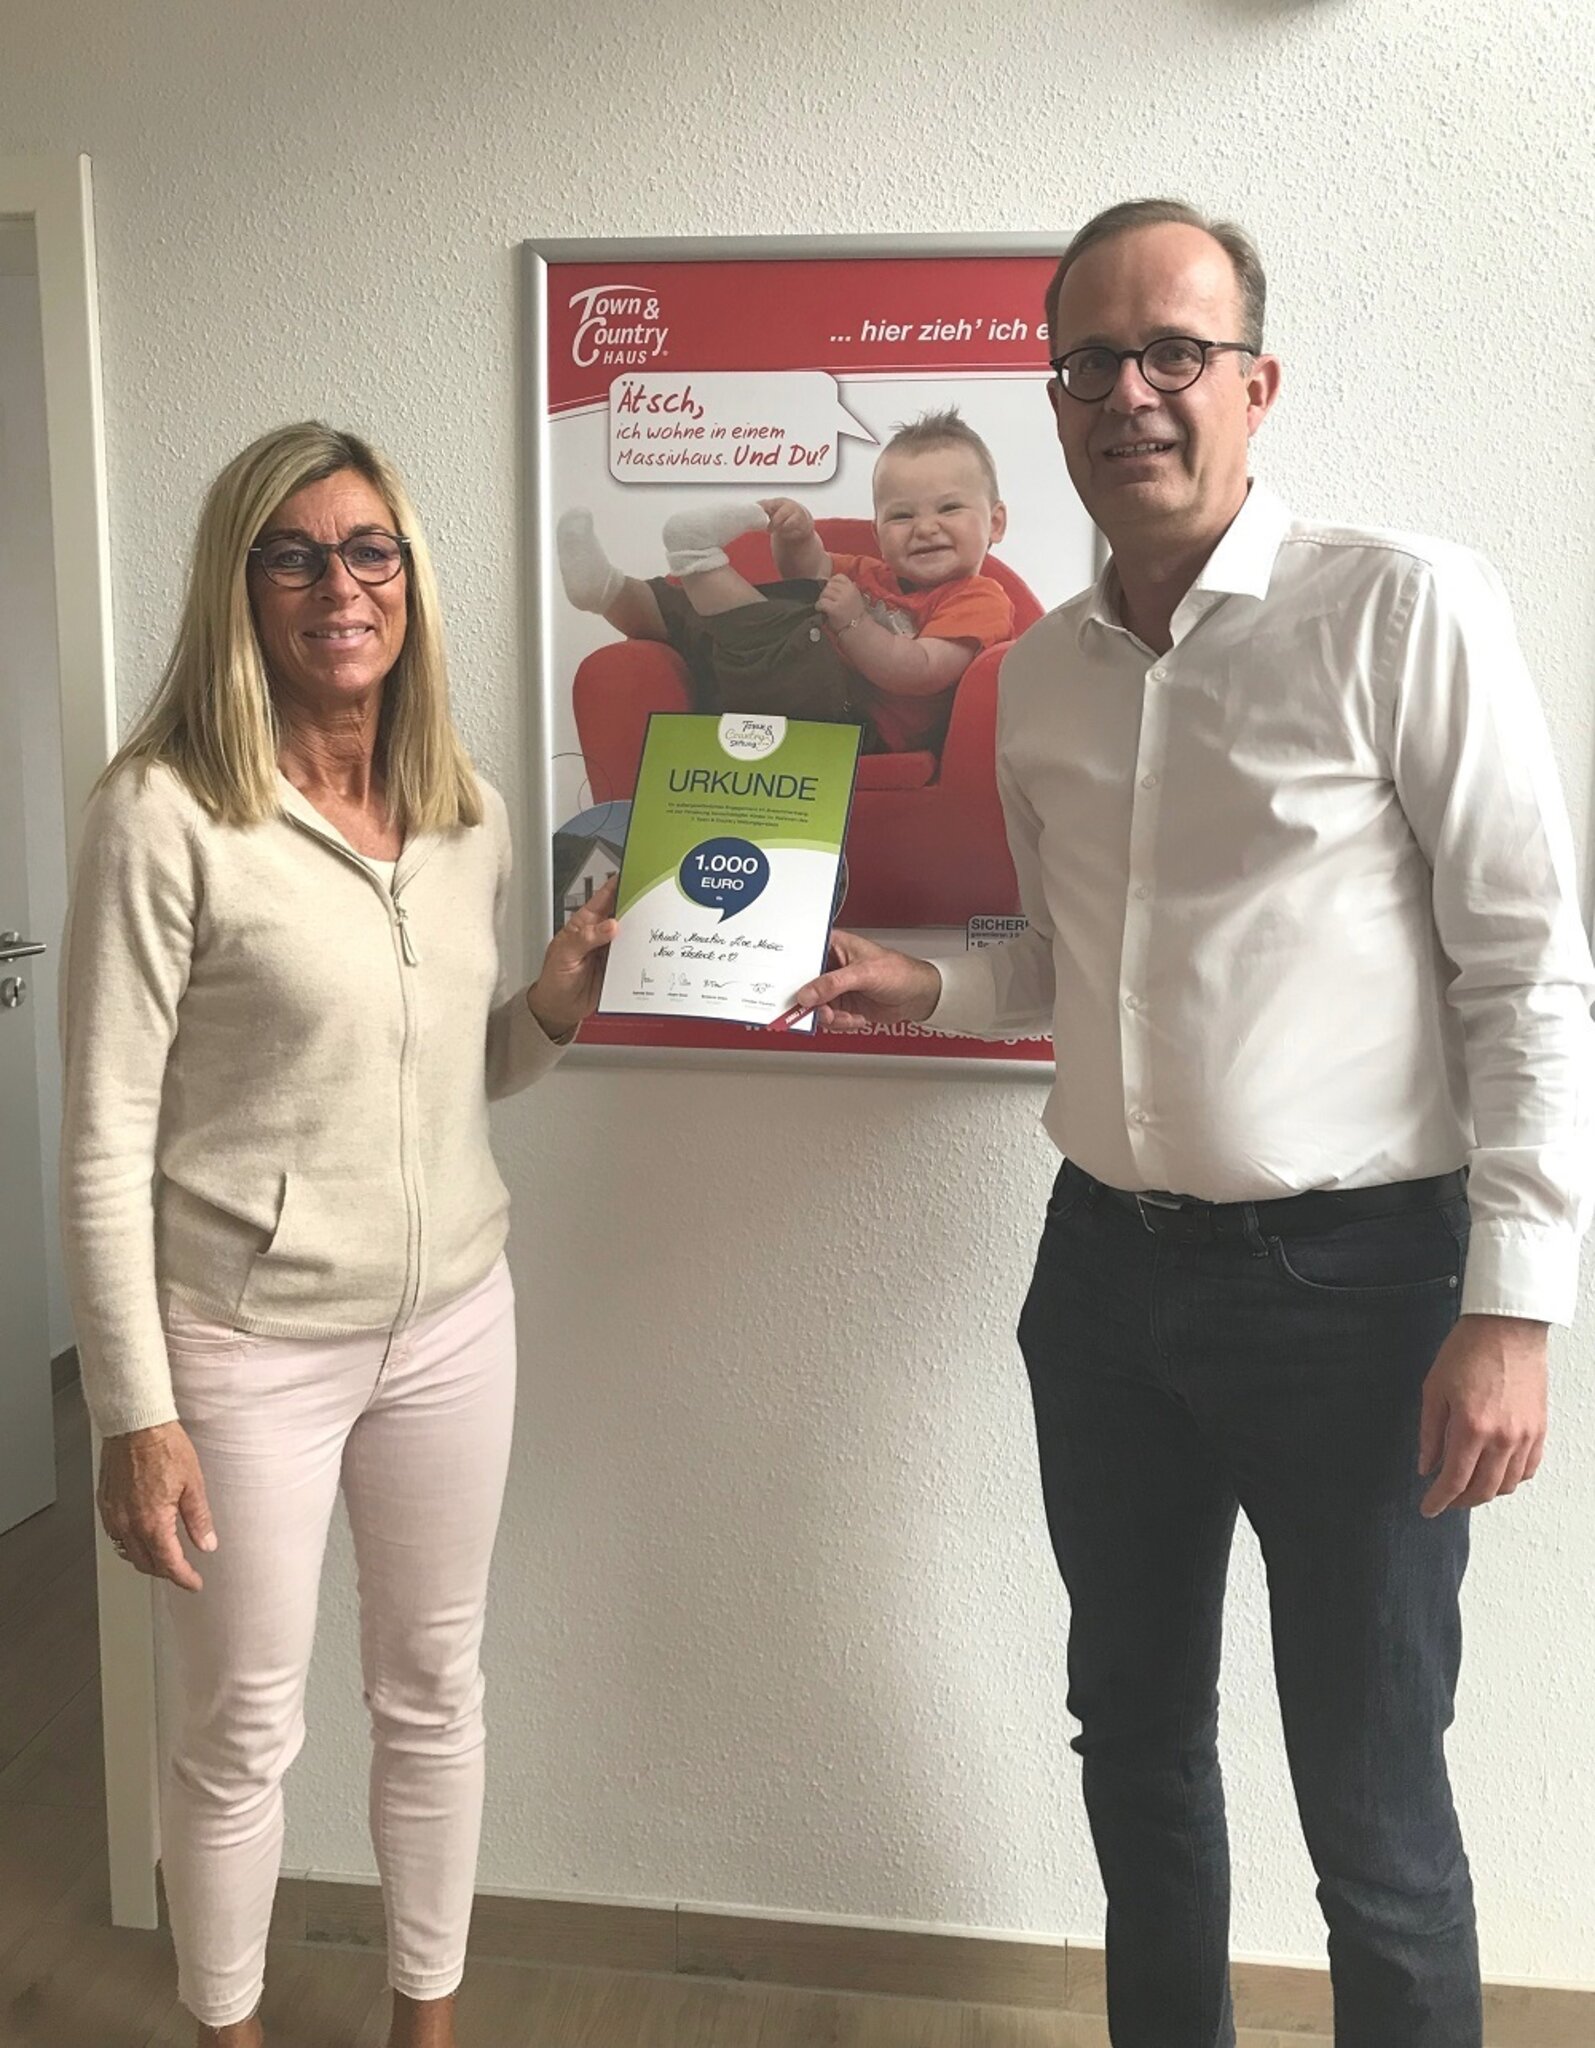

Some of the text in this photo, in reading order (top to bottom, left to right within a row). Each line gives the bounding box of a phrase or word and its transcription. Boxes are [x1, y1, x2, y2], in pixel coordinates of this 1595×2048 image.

[568, 284, 660, 325] Town &
[860, 319, 913, 342] hier
[987, 317, 1028, 341] ich
[572, 316, 669, 368] Country
[603, 350, 647, 365] HAUS
[616, 380, 704, 420] Ätsch,
[616, 422, 786, 440] ich wohne in einem
[616, 443, 831, 467] Massivhaus. Und Du?
[669, 769, 819, 801] URKUNDE
[694, 853, 759, 875] 1.000
[701, 876, 745, 891] EURO
